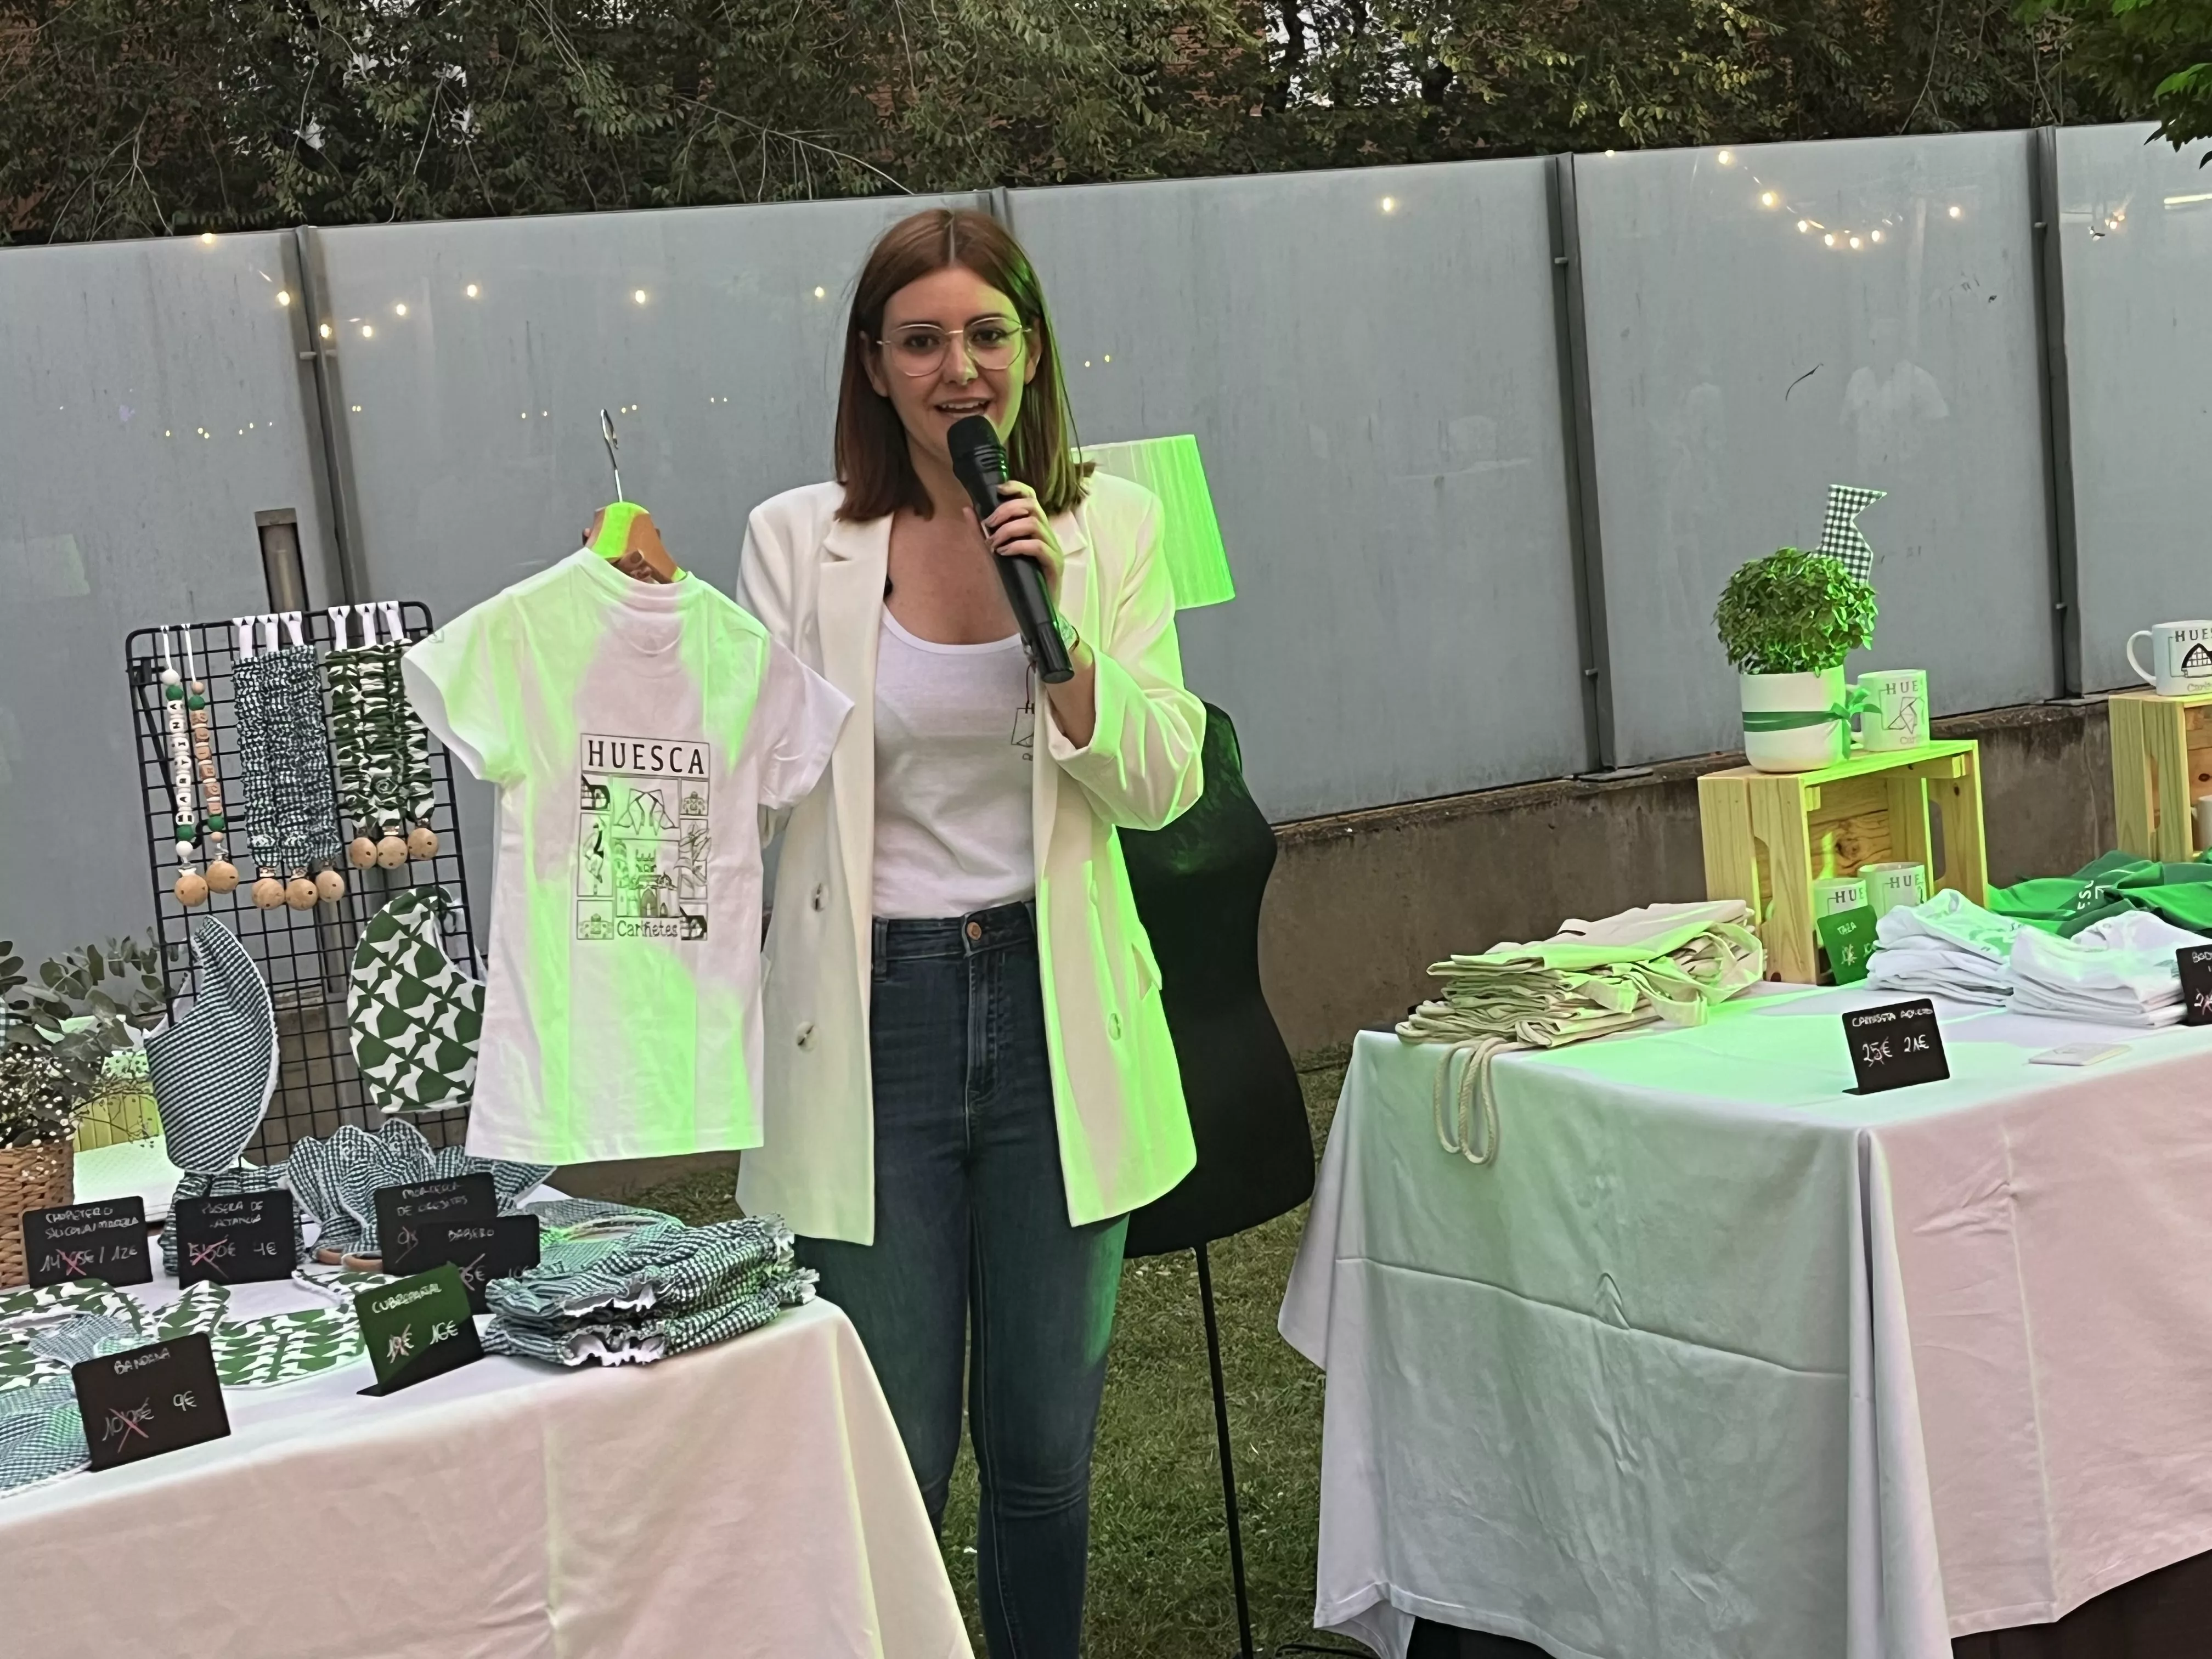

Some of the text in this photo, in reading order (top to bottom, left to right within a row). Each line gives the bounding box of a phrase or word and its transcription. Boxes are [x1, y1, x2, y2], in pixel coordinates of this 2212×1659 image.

[588, 740, 704, 775] HUESCA
[251, 1200, 264, 1211] DE
[173, 1390, 198, 1412] 9€
